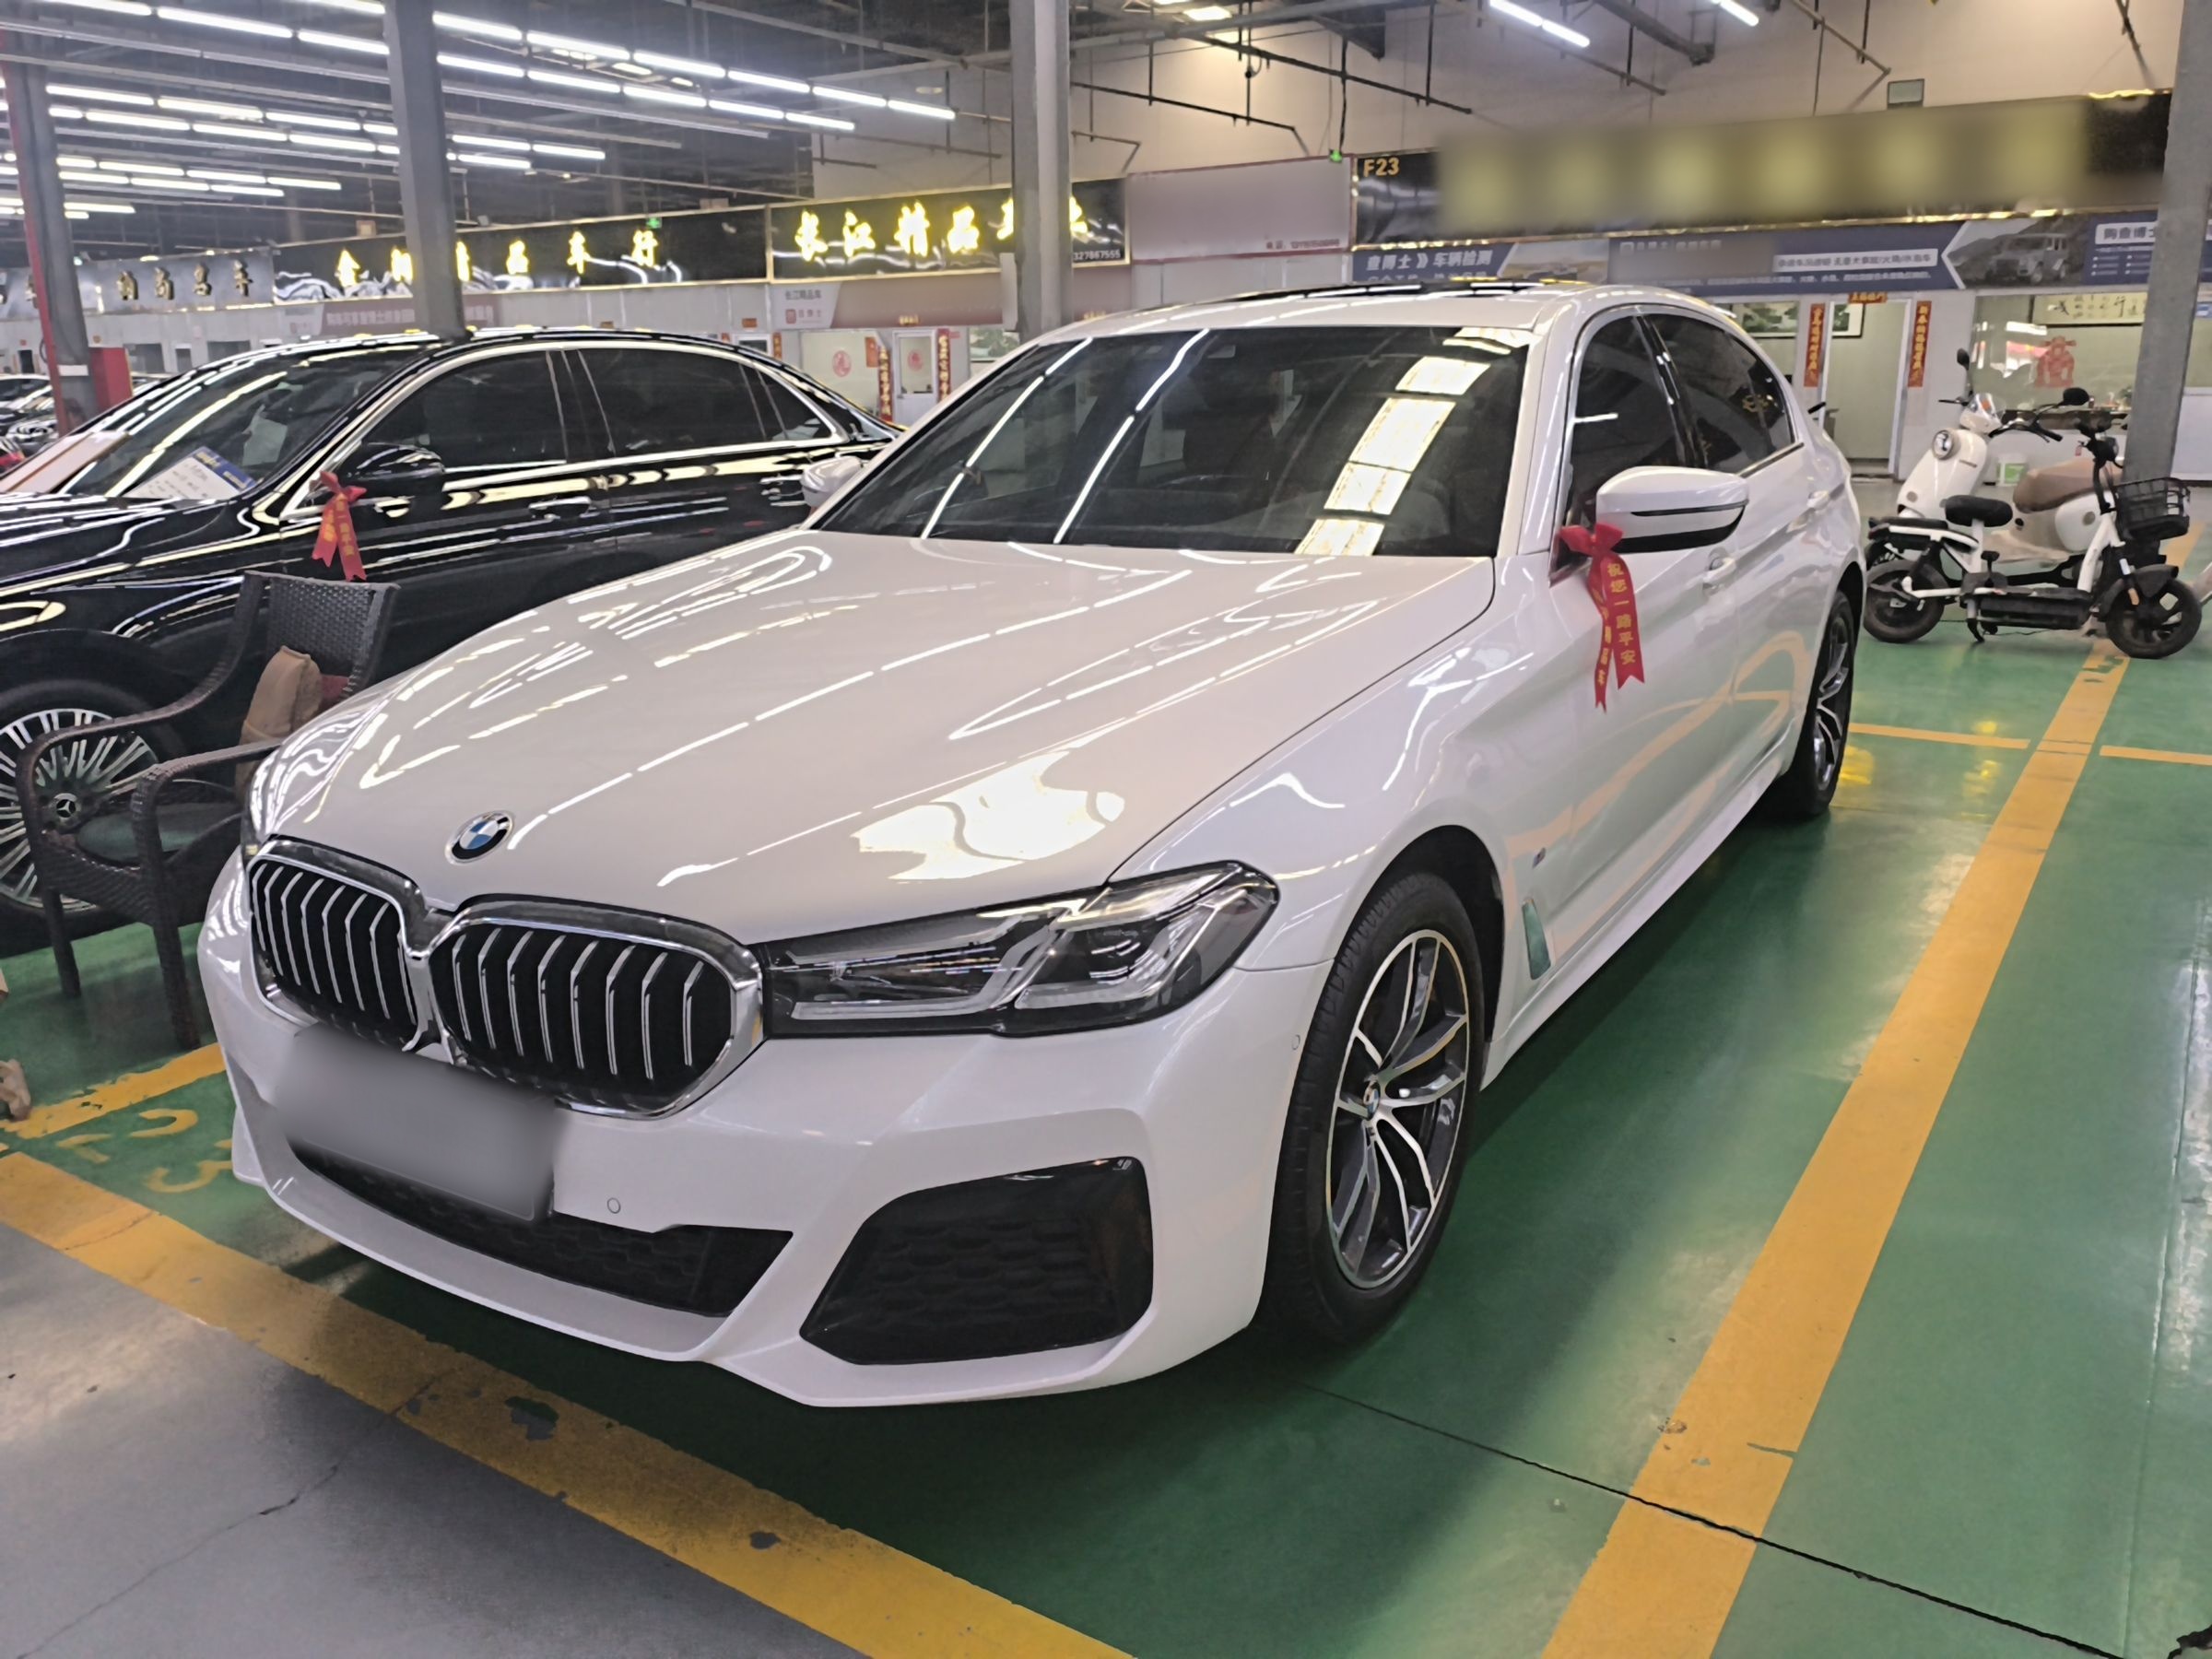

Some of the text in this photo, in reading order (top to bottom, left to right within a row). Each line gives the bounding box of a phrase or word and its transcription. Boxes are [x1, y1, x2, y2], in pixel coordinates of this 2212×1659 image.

[1363, 158, 1400, 177] F23
[1606, 563, 1636, 665] 祝您一路平安
